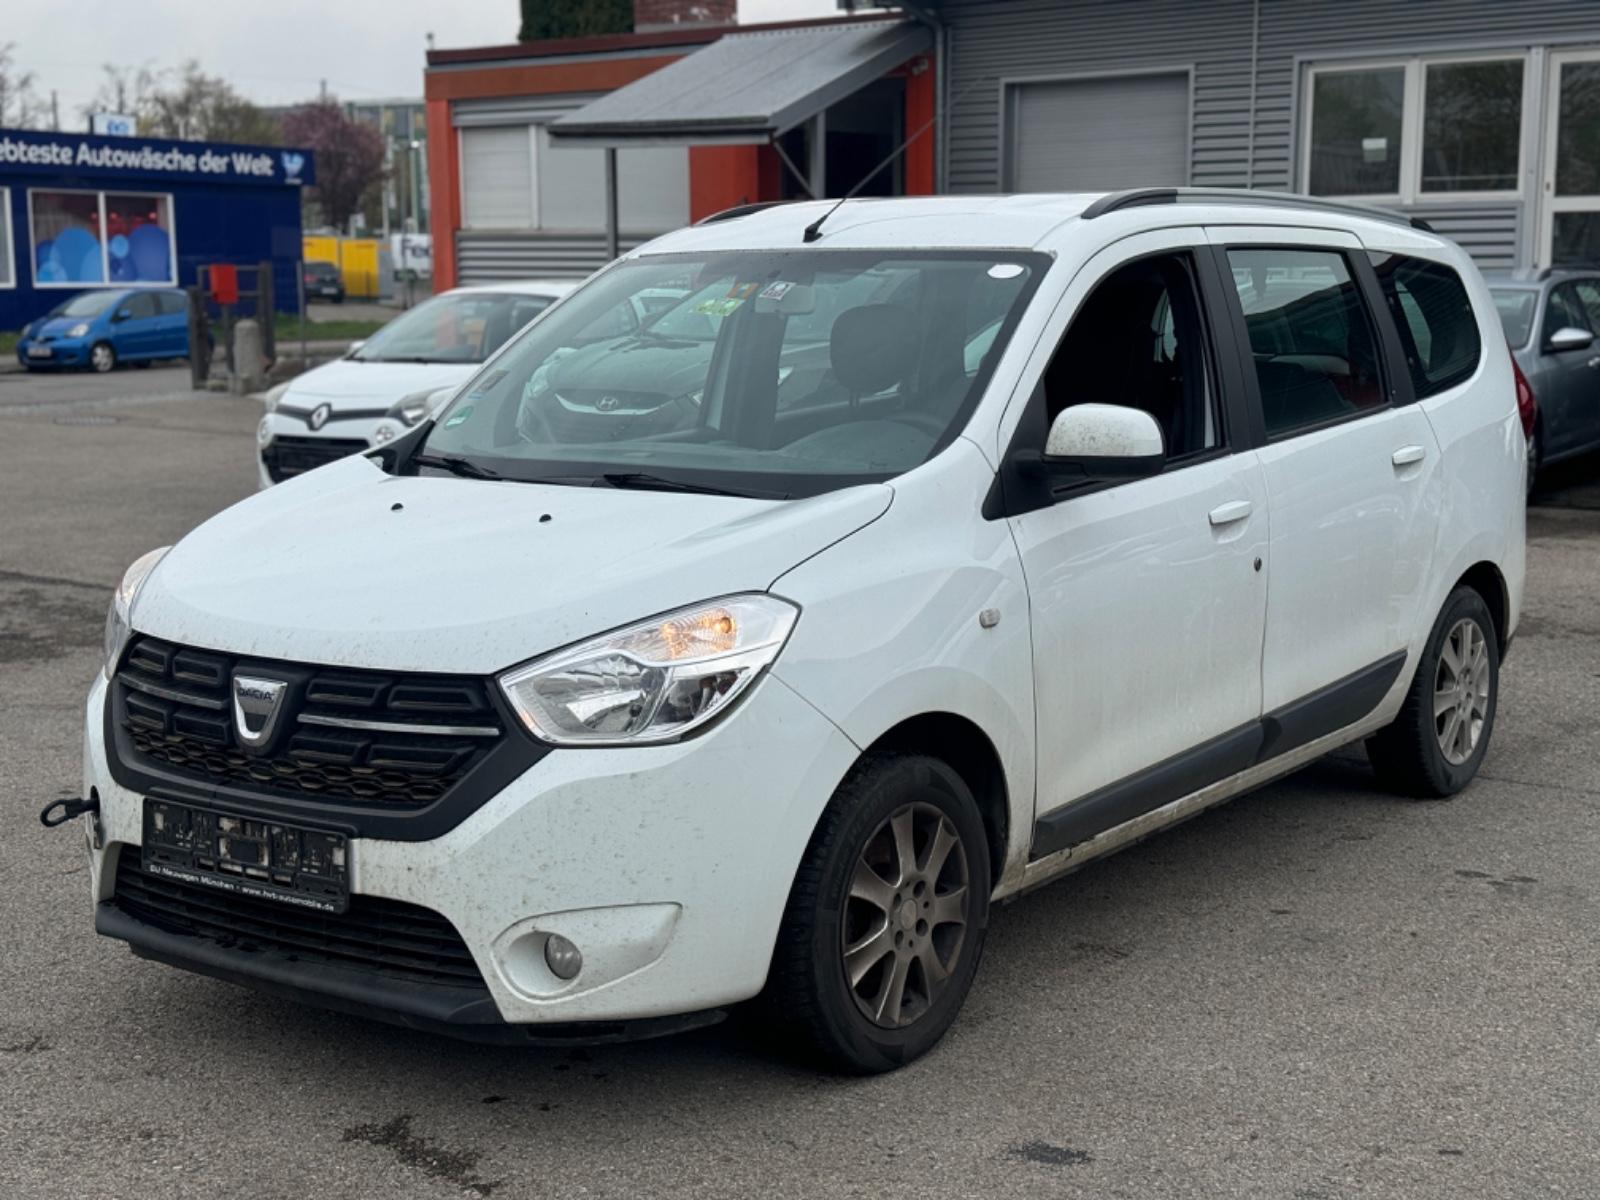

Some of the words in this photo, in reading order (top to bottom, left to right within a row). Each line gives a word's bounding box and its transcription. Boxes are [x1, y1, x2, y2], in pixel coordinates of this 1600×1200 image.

[76, 142, 196, 172] Autowäsche
[199, 149, 229, 173] der
[231, 152, 274, 176] Welt
[239, 686, 272, 701] DACIA
[162, 867, 200, 882] Neuwagen
[201, 875, 234, 890] München
